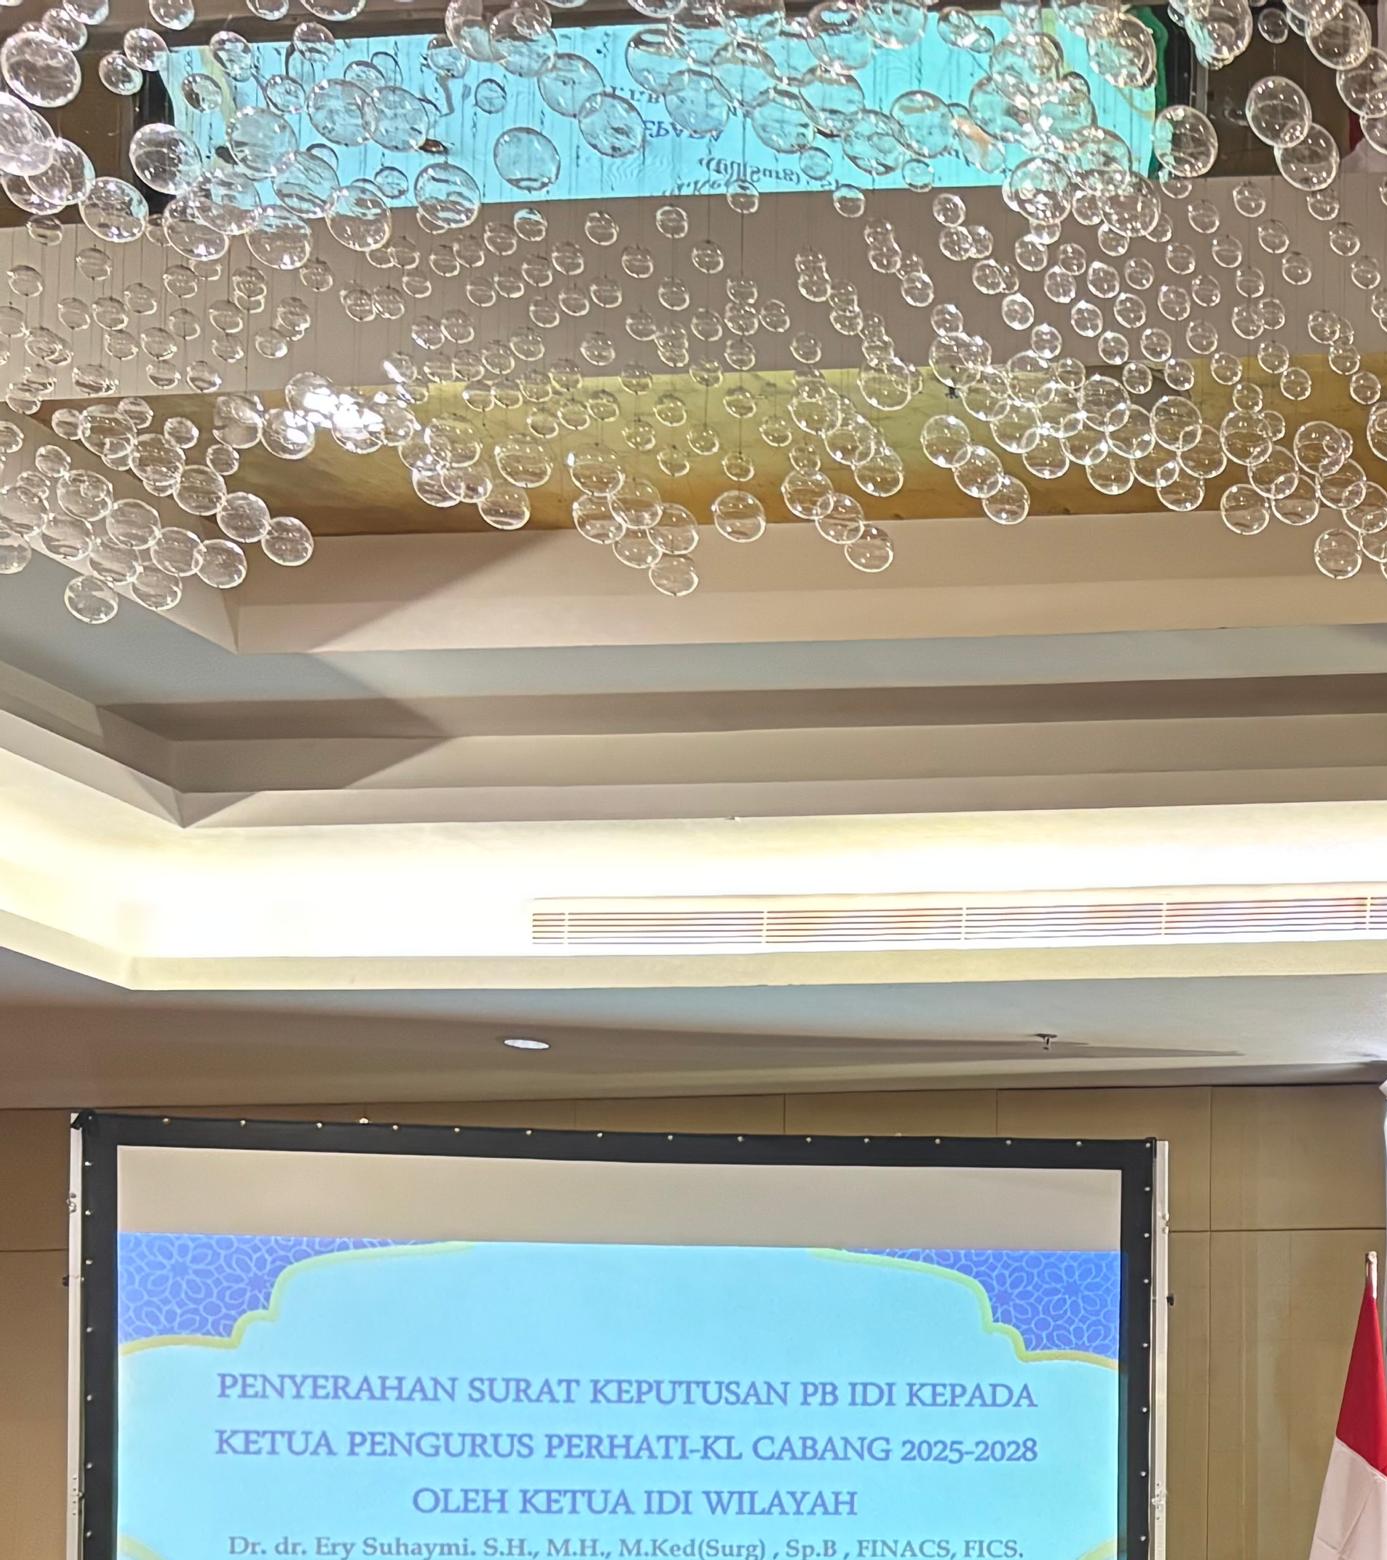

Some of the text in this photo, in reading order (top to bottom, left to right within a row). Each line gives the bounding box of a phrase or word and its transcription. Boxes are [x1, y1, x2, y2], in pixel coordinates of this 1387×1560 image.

[217, 1373, 1038, 1408] PENYERAHAN SURAT KEPUTUSAN PB IDI KEPADA
[215, 1429, 1038, 1464] KETUA PENGURUS PERHATI-KL CABANG 2025-2028
[413, 1487, 858, 1516] OLEH KETUA IDI WILAYAH
[228, 1536, 267, 1556] Dr.
[274, 1536, 307, 1556] dr.
[315, 1537, 356, 1560] Ery
[483, 1538, 540, 1560] S.H.,
[546, 1538, 612, 1560] M.H.,
[856, 1539, 956, 1560] FINACS,
[963, 1539, 1024, 1559] FICS.
